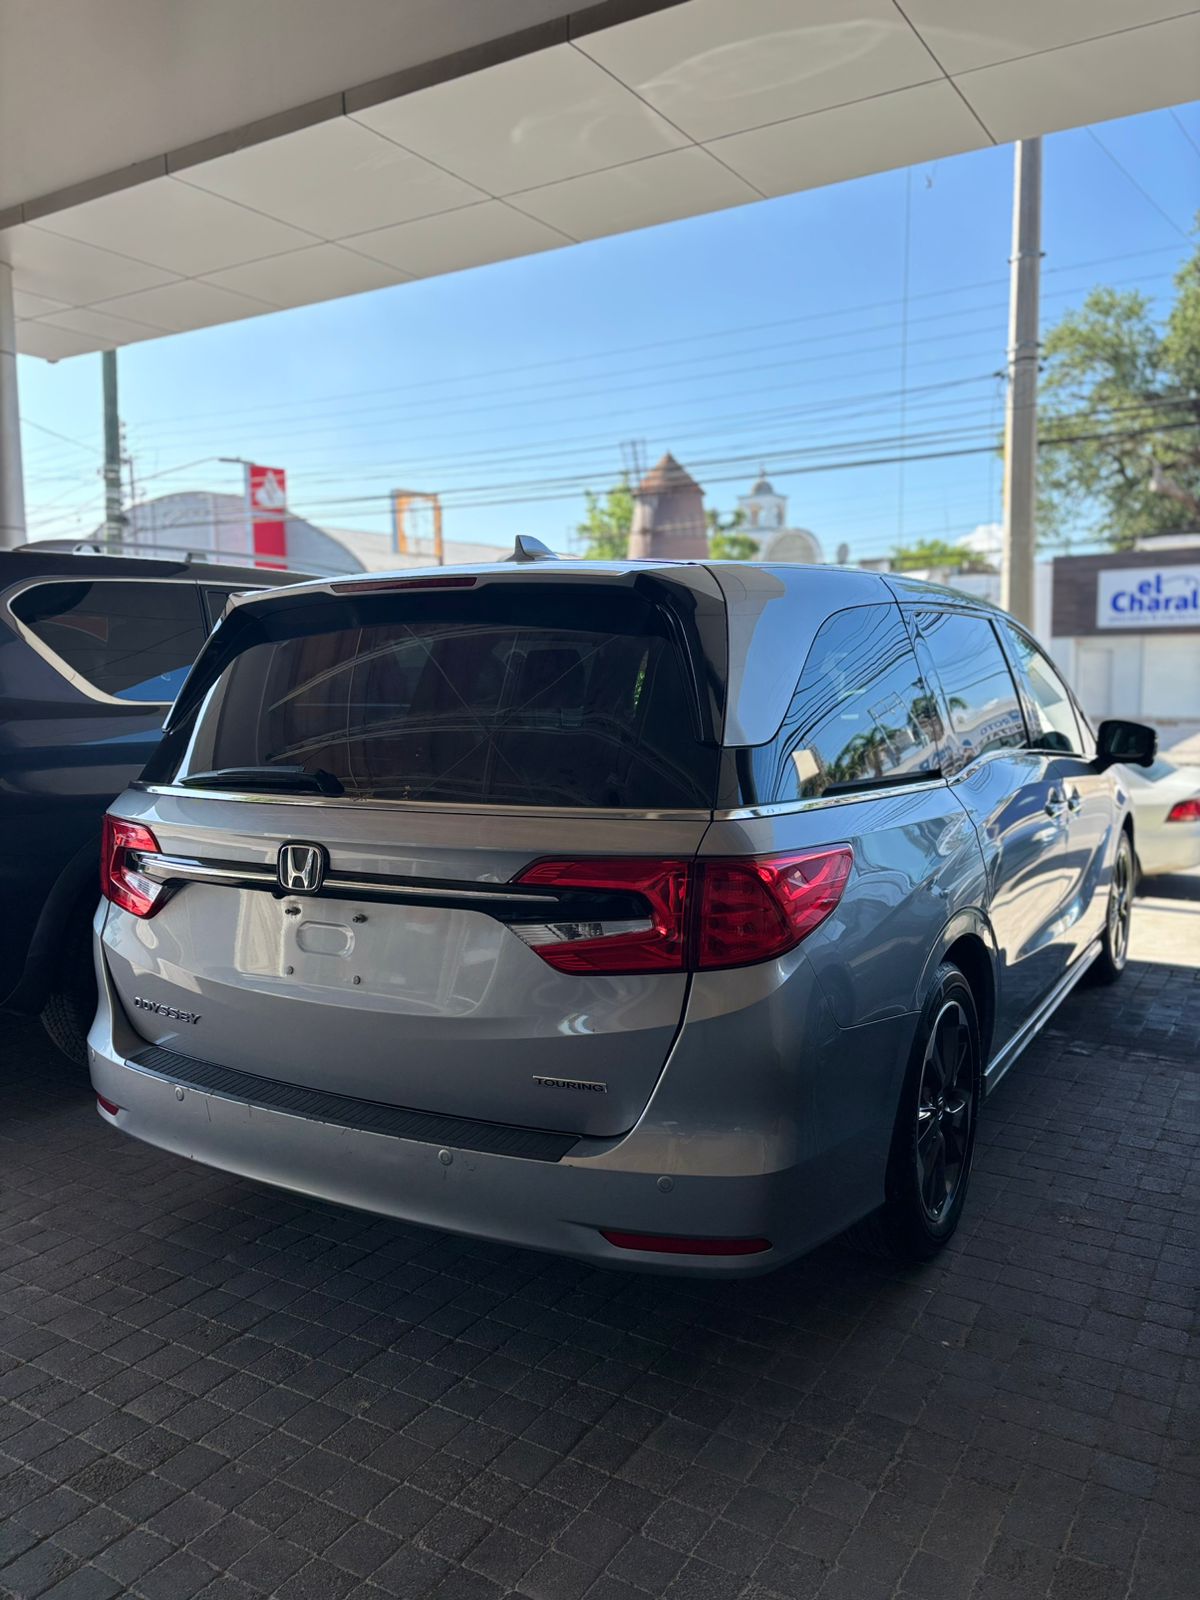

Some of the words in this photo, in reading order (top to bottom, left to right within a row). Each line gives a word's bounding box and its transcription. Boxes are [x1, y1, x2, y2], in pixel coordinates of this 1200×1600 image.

[1137, 573, 1163, 595] el
[1111, 589, 1199, 613] Charal
[133, 996, 202, 1025] ODYSSEY
[534, 1077, 605, 1093] TOURING
